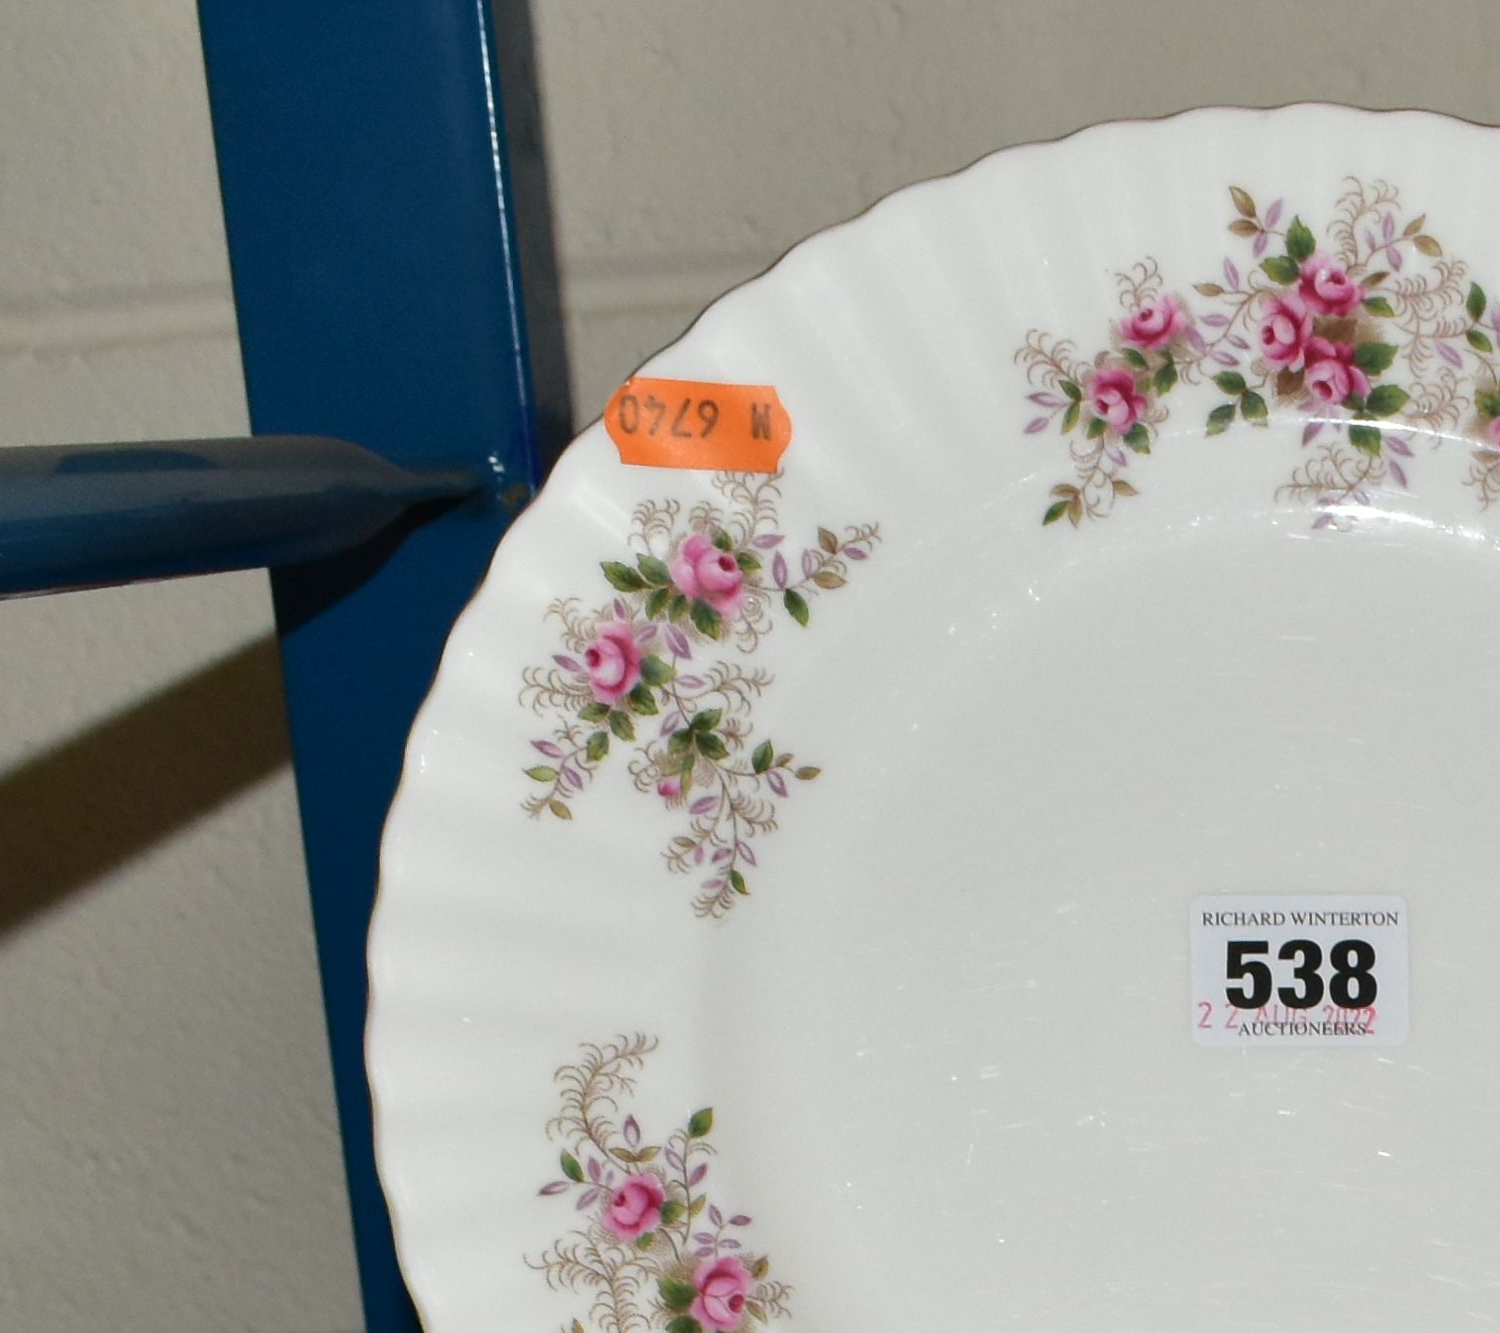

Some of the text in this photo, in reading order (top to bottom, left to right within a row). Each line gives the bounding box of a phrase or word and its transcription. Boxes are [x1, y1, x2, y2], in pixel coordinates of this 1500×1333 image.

[618, 393, 719, 439] 6740
[1202, 911, 1399, 927] RICHARD WINTERTON
[1225, 938, 1378, 1010] 538
[1238, 1021, 1367, 1037] AUCTIONEERS
